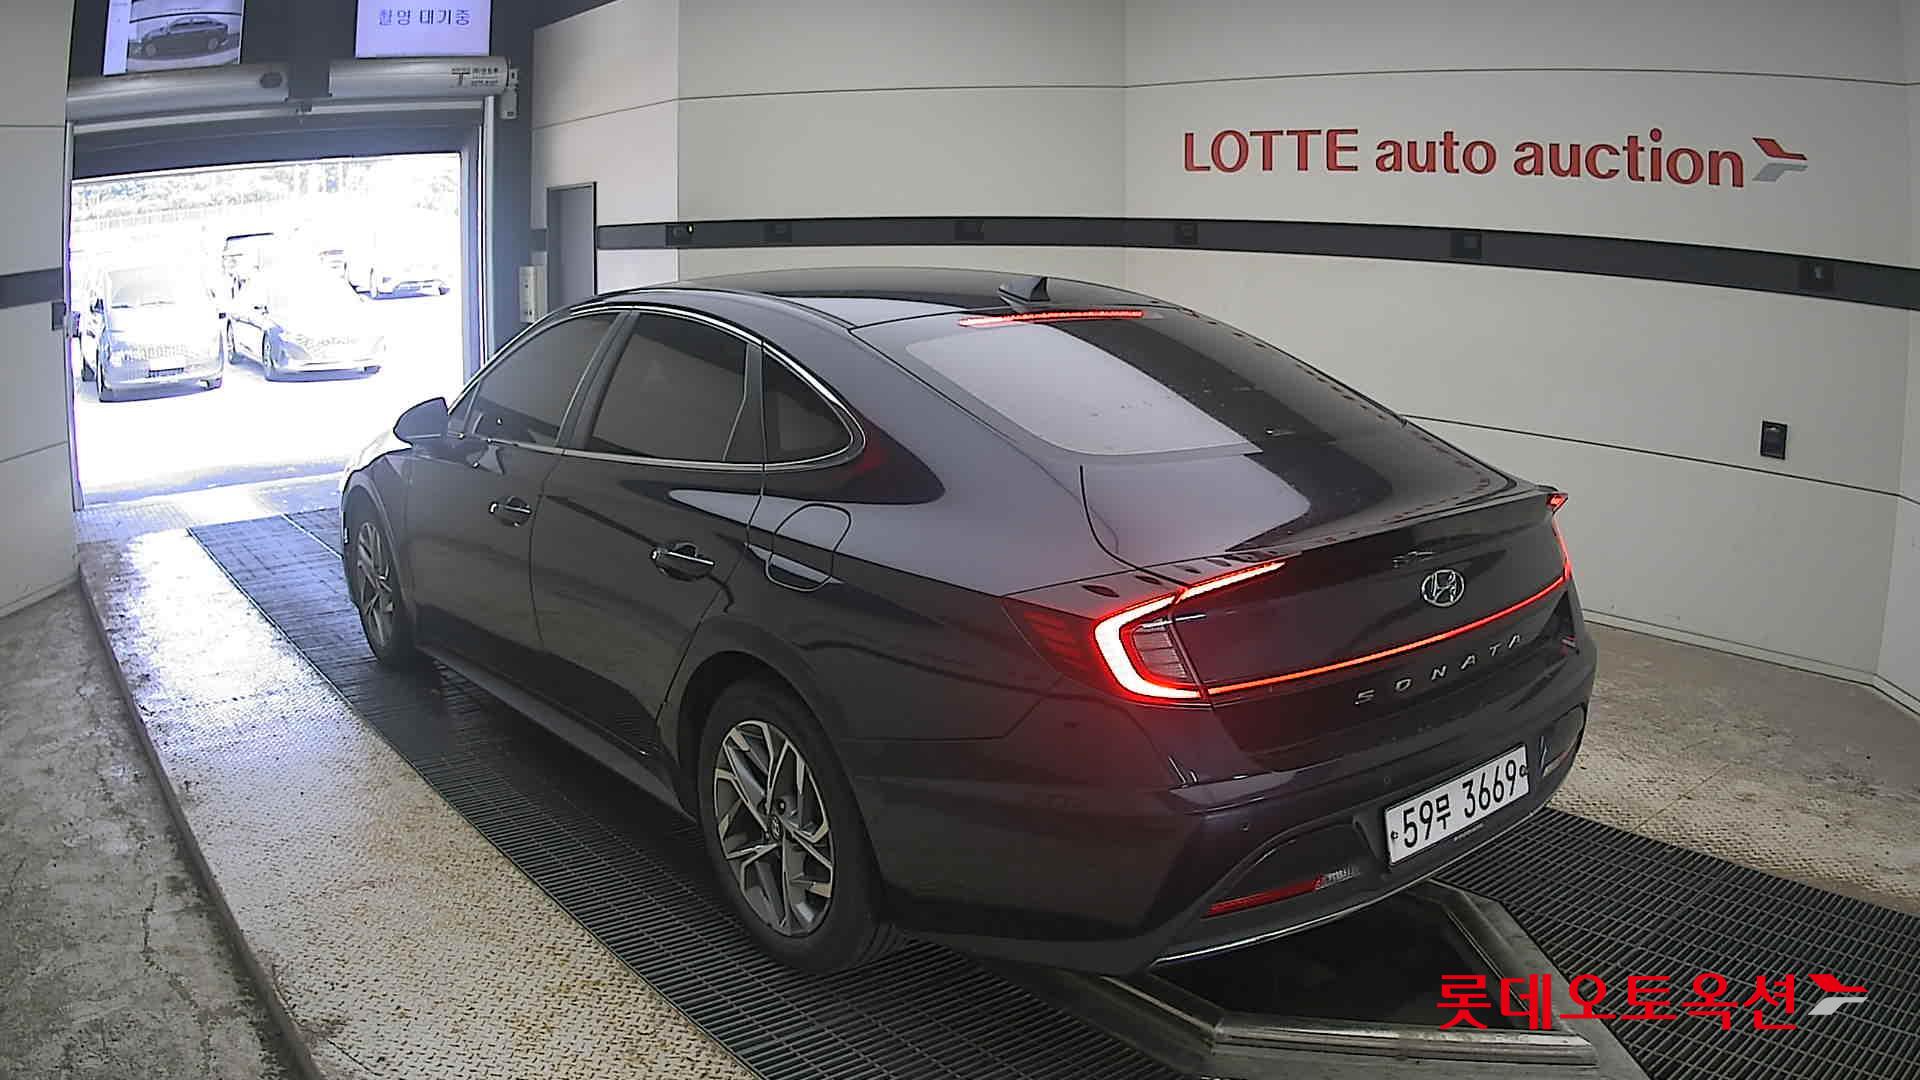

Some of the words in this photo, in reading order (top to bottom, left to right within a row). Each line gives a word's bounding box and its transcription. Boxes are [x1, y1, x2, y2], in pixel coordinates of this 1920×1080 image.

[419, 9, 471, 26] 대기중
[1184, 129, 1359, 173] LOTTE
[1375, 131, 1496, 175] auto
[1513, 129, 1744, 187] auction
[1355, 633, 1522, 704] SONATA
[1403, 794, 1452, 848] 59무
[1462, 759, 1516, 818] 3669
